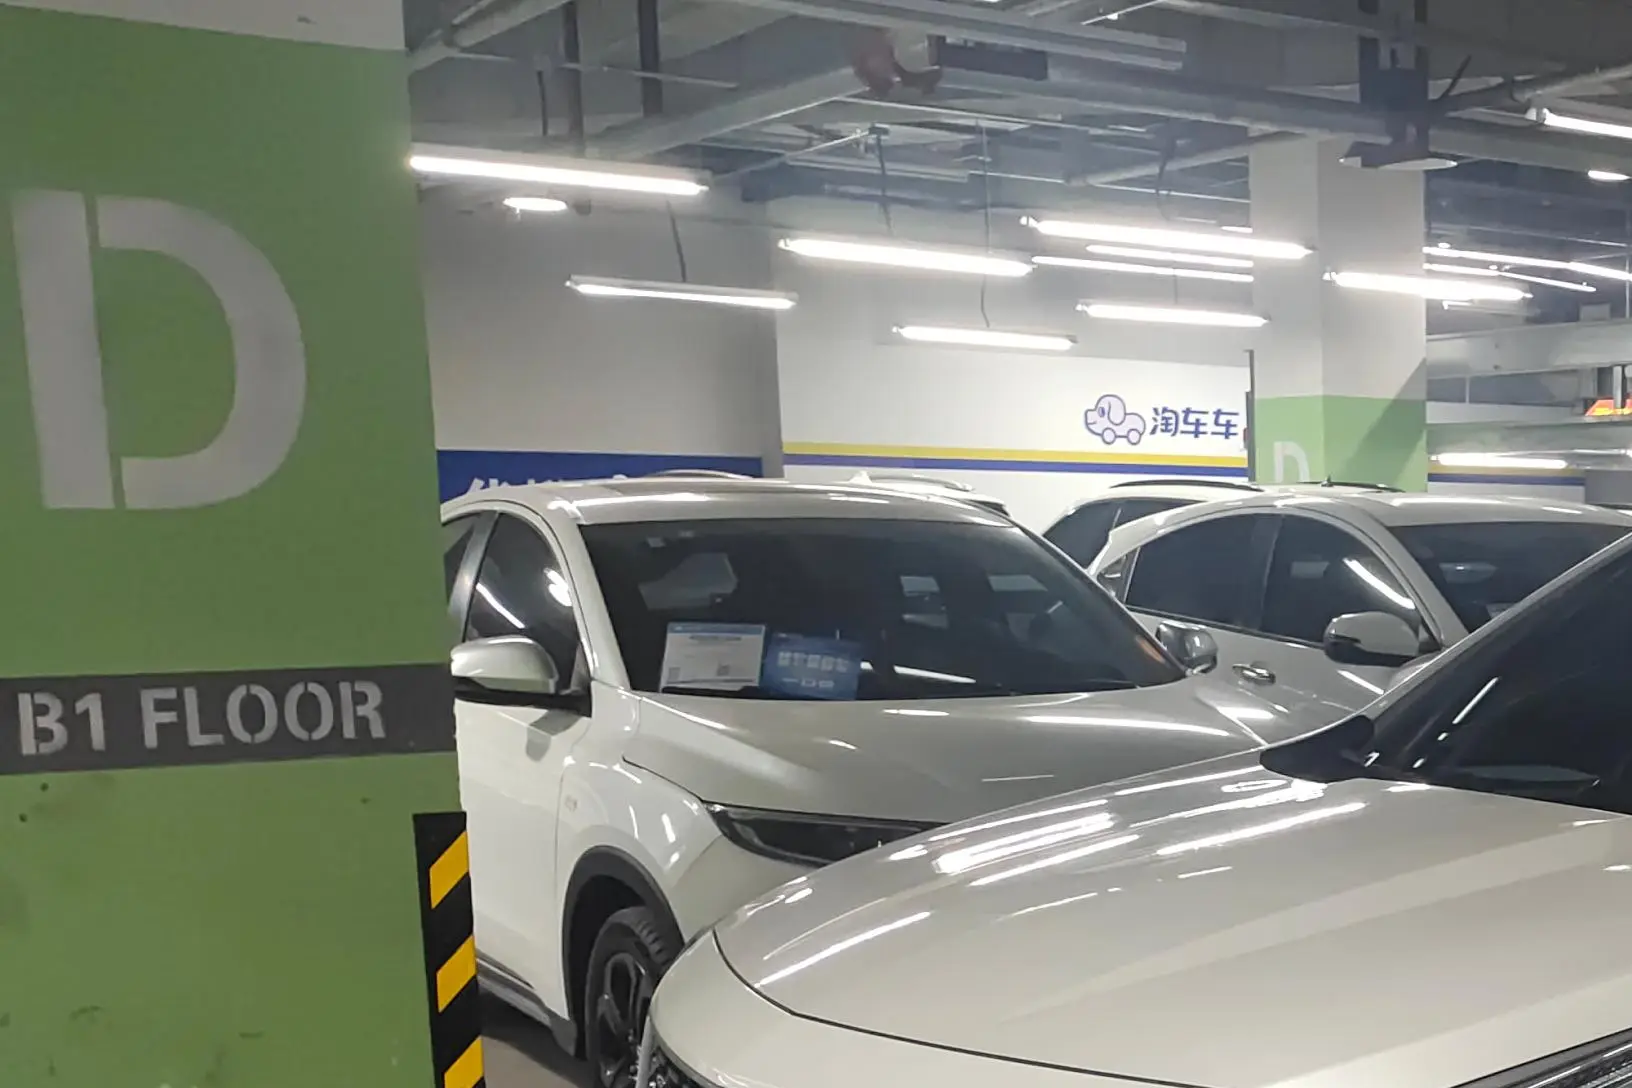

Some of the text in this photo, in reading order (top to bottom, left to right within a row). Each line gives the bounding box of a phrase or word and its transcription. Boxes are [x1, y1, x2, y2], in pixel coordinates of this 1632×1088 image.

[11, 190, 306, 510] D
[1149, 406, 1240, 439] 淘车车
[17, 680, 387, 756] B1 FLOOR
